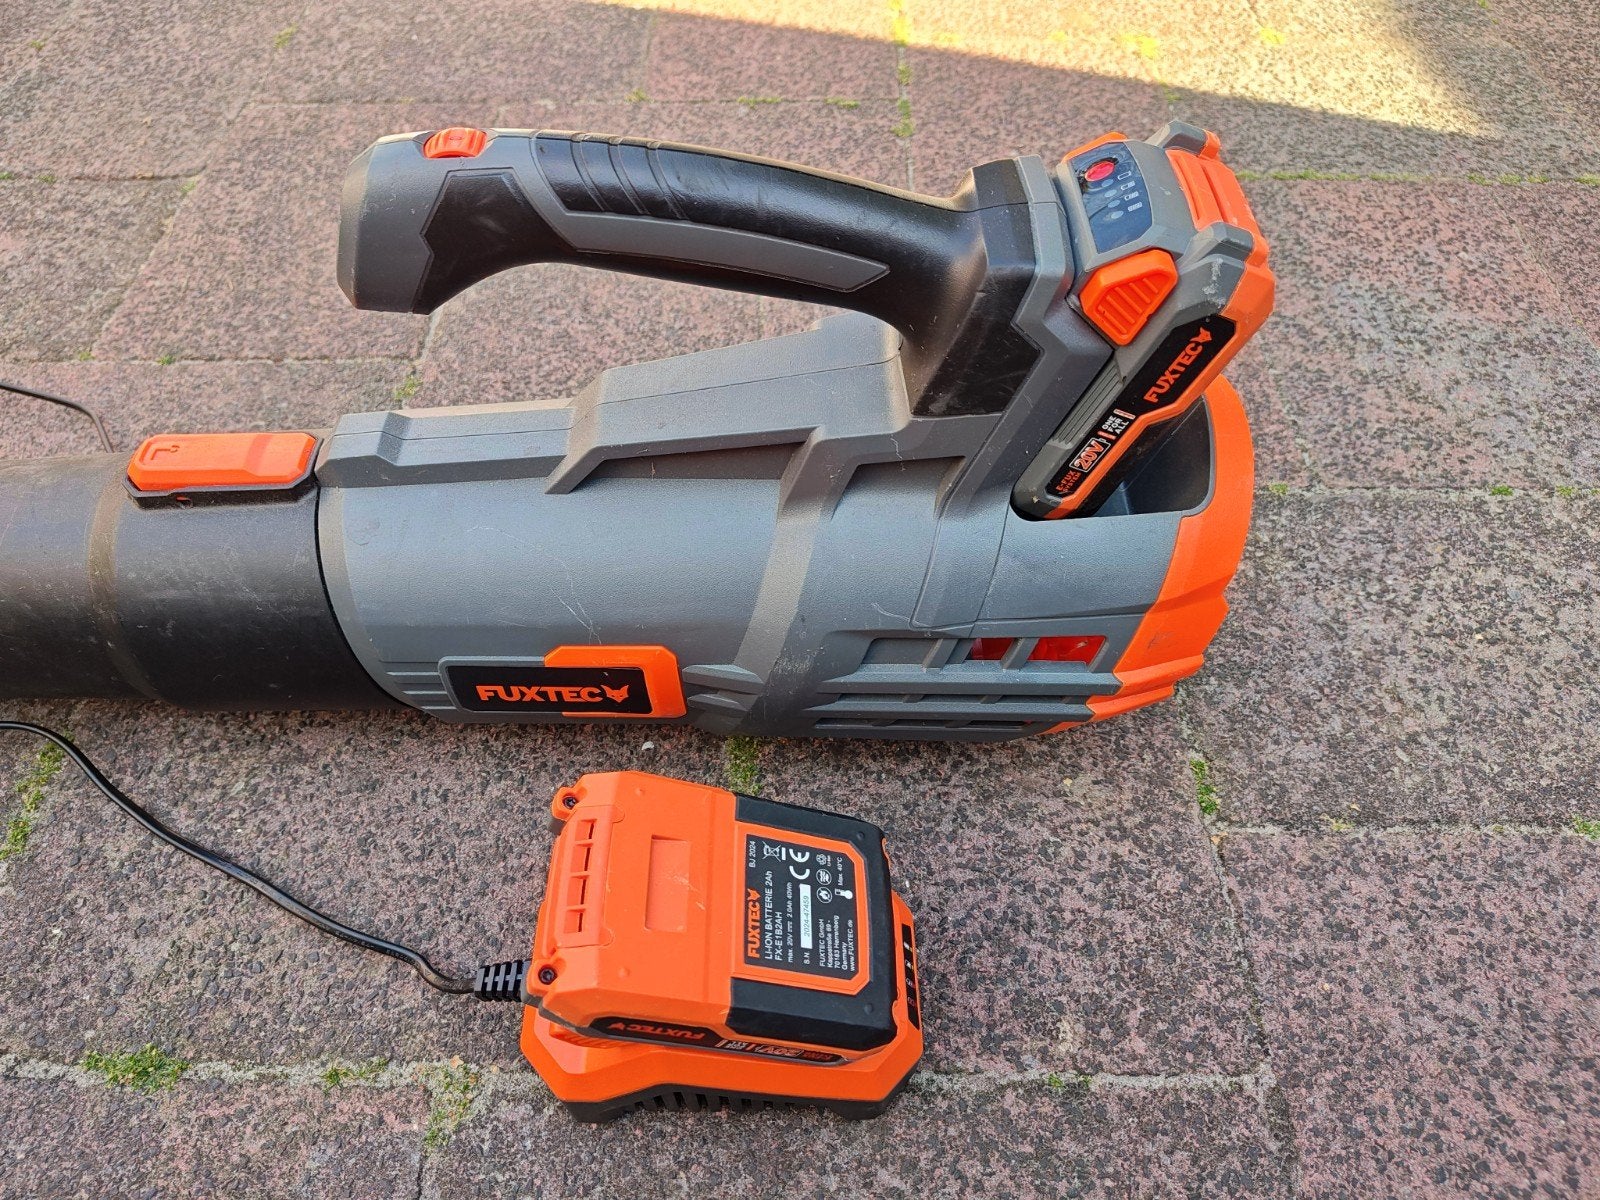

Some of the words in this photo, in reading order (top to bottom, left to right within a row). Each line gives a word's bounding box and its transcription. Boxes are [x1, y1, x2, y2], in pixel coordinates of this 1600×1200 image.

[1143, 342, 1203, 403] FUXTEC
[1101, 415, 1117, 430] ONE
[1107, 418, 1123, 433] FOR
[1115, 420, 1130, 435] ALL
[1073, 440, 1105, 470] 20V
[475, 685, 603, 702] FUXTEC
[748, 840, 756, 859] 2024
[748, 859, 756, 868] BJ
[764, 871, 773, 887] 2Ah
[764, 888, 773, 930] BATTERIE
[748, 900, 761, 958] FUXTEC
[774, 911, 783, 961] FX-E1B2AH
[764, 931, 773, 960] LI-ION
[841, 941, 849, 970] Germany
[627, 1023, 706, 1040] FUXTEC
